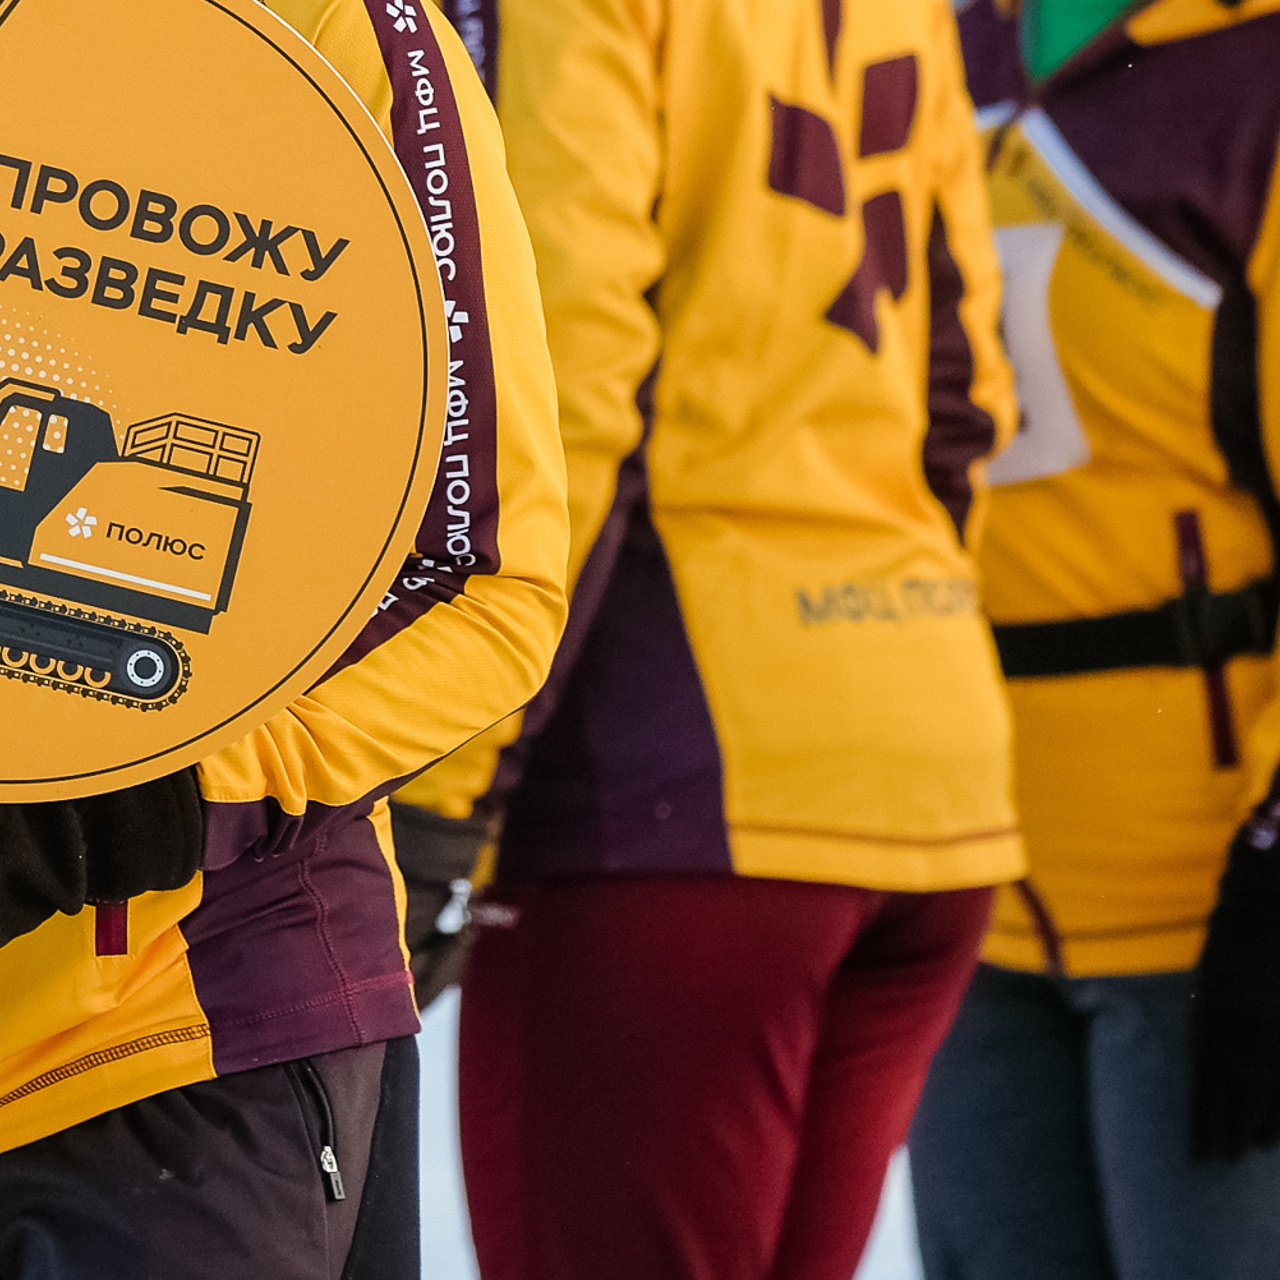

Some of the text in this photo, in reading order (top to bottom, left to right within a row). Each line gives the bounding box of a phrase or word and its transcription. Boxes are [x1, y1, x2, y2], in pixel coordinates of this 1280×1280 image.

[408, 49, 457, 281] МФЦ ПОЛЮС
[106, 522, 207, 561] ПОЛЮС
[445, 454, 476, 567] ПОЛЮС
